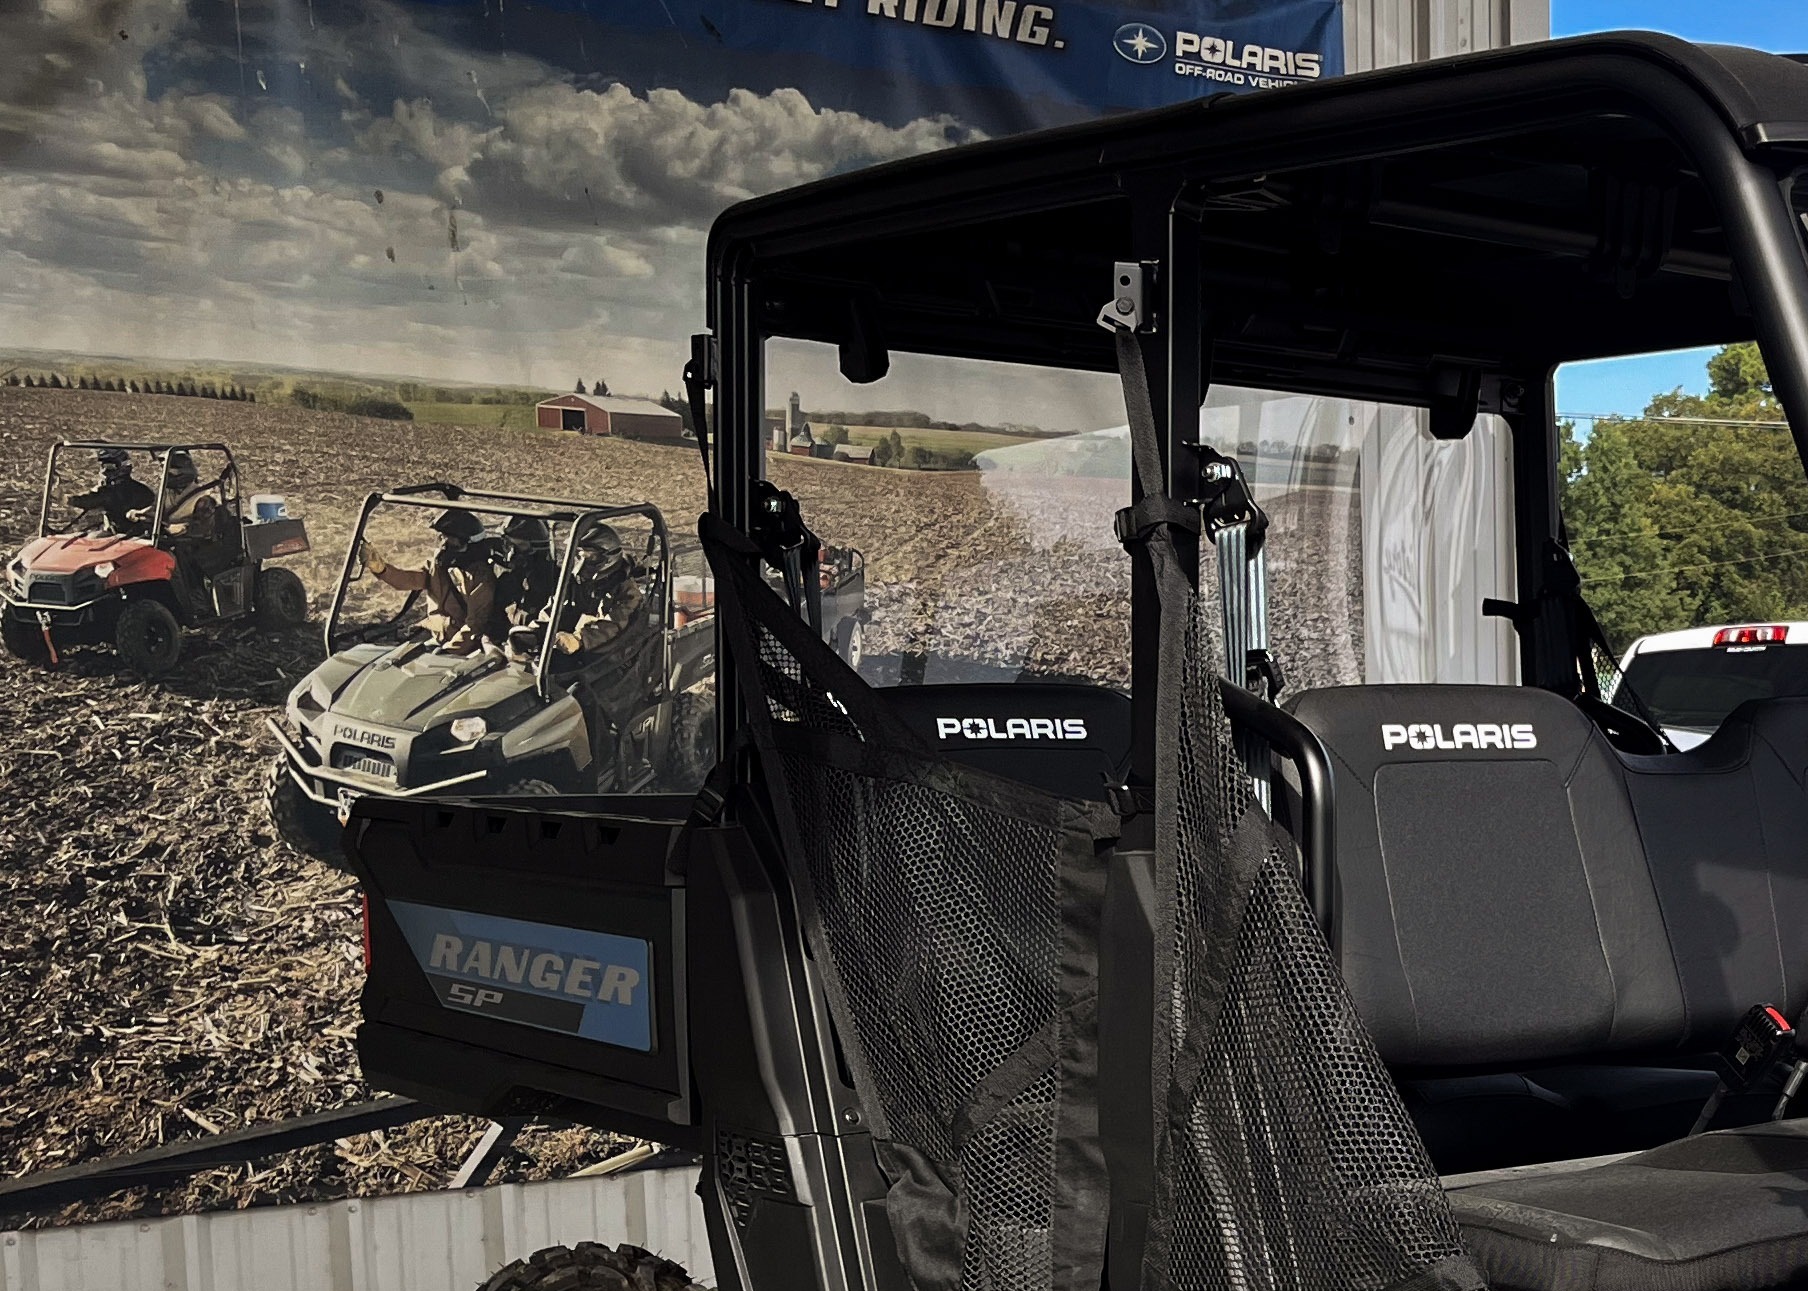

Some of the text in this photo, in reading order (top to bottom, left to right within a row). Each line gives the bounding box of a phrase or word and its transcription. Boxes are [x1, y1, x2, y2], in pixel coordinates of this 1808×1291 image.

[1175, 31, 1321, 78] POLARIS
[1174, 63, 1245, 85] OFF-ROAD
[333, 723, 397, 749] POLARIS
[936, 717, 1088, 740] POLARIS
[1381, 723, 1538, 751] POLARIS
[428, 933, 640, 1006] RANGER
[447, 983, 504, 1007] SP
